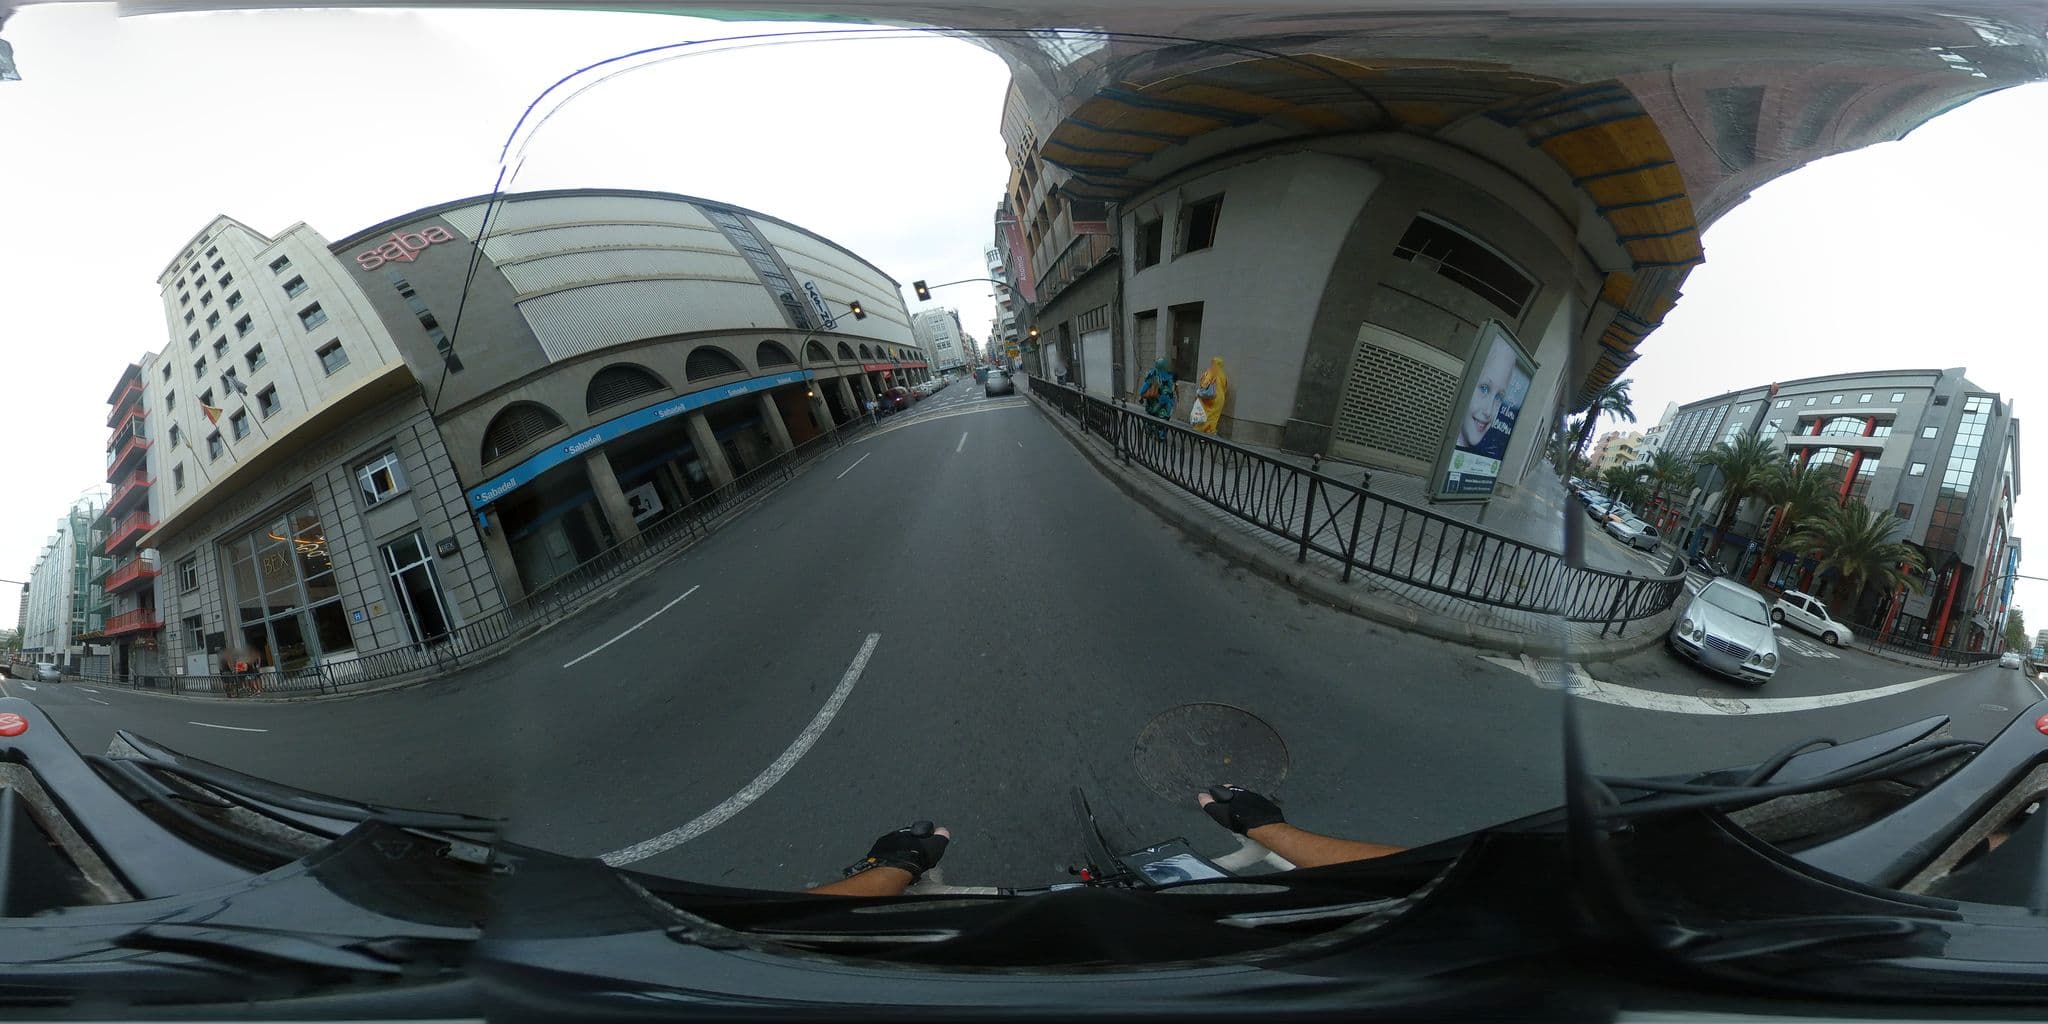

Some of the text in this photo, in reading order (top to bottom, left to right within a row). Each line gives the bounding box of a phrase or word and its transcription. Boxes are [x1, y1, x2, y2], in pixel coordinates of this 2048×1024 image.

[356, 226, 455, 271] saba
[804, 281, 833, 328] CASINO
[658, 403, 686, 418] Sabadell
[568, 433, 602, 455] Sabadell
[480, 477, 517, 502] Sabadell
[263, 551, 288, 576] BEX
